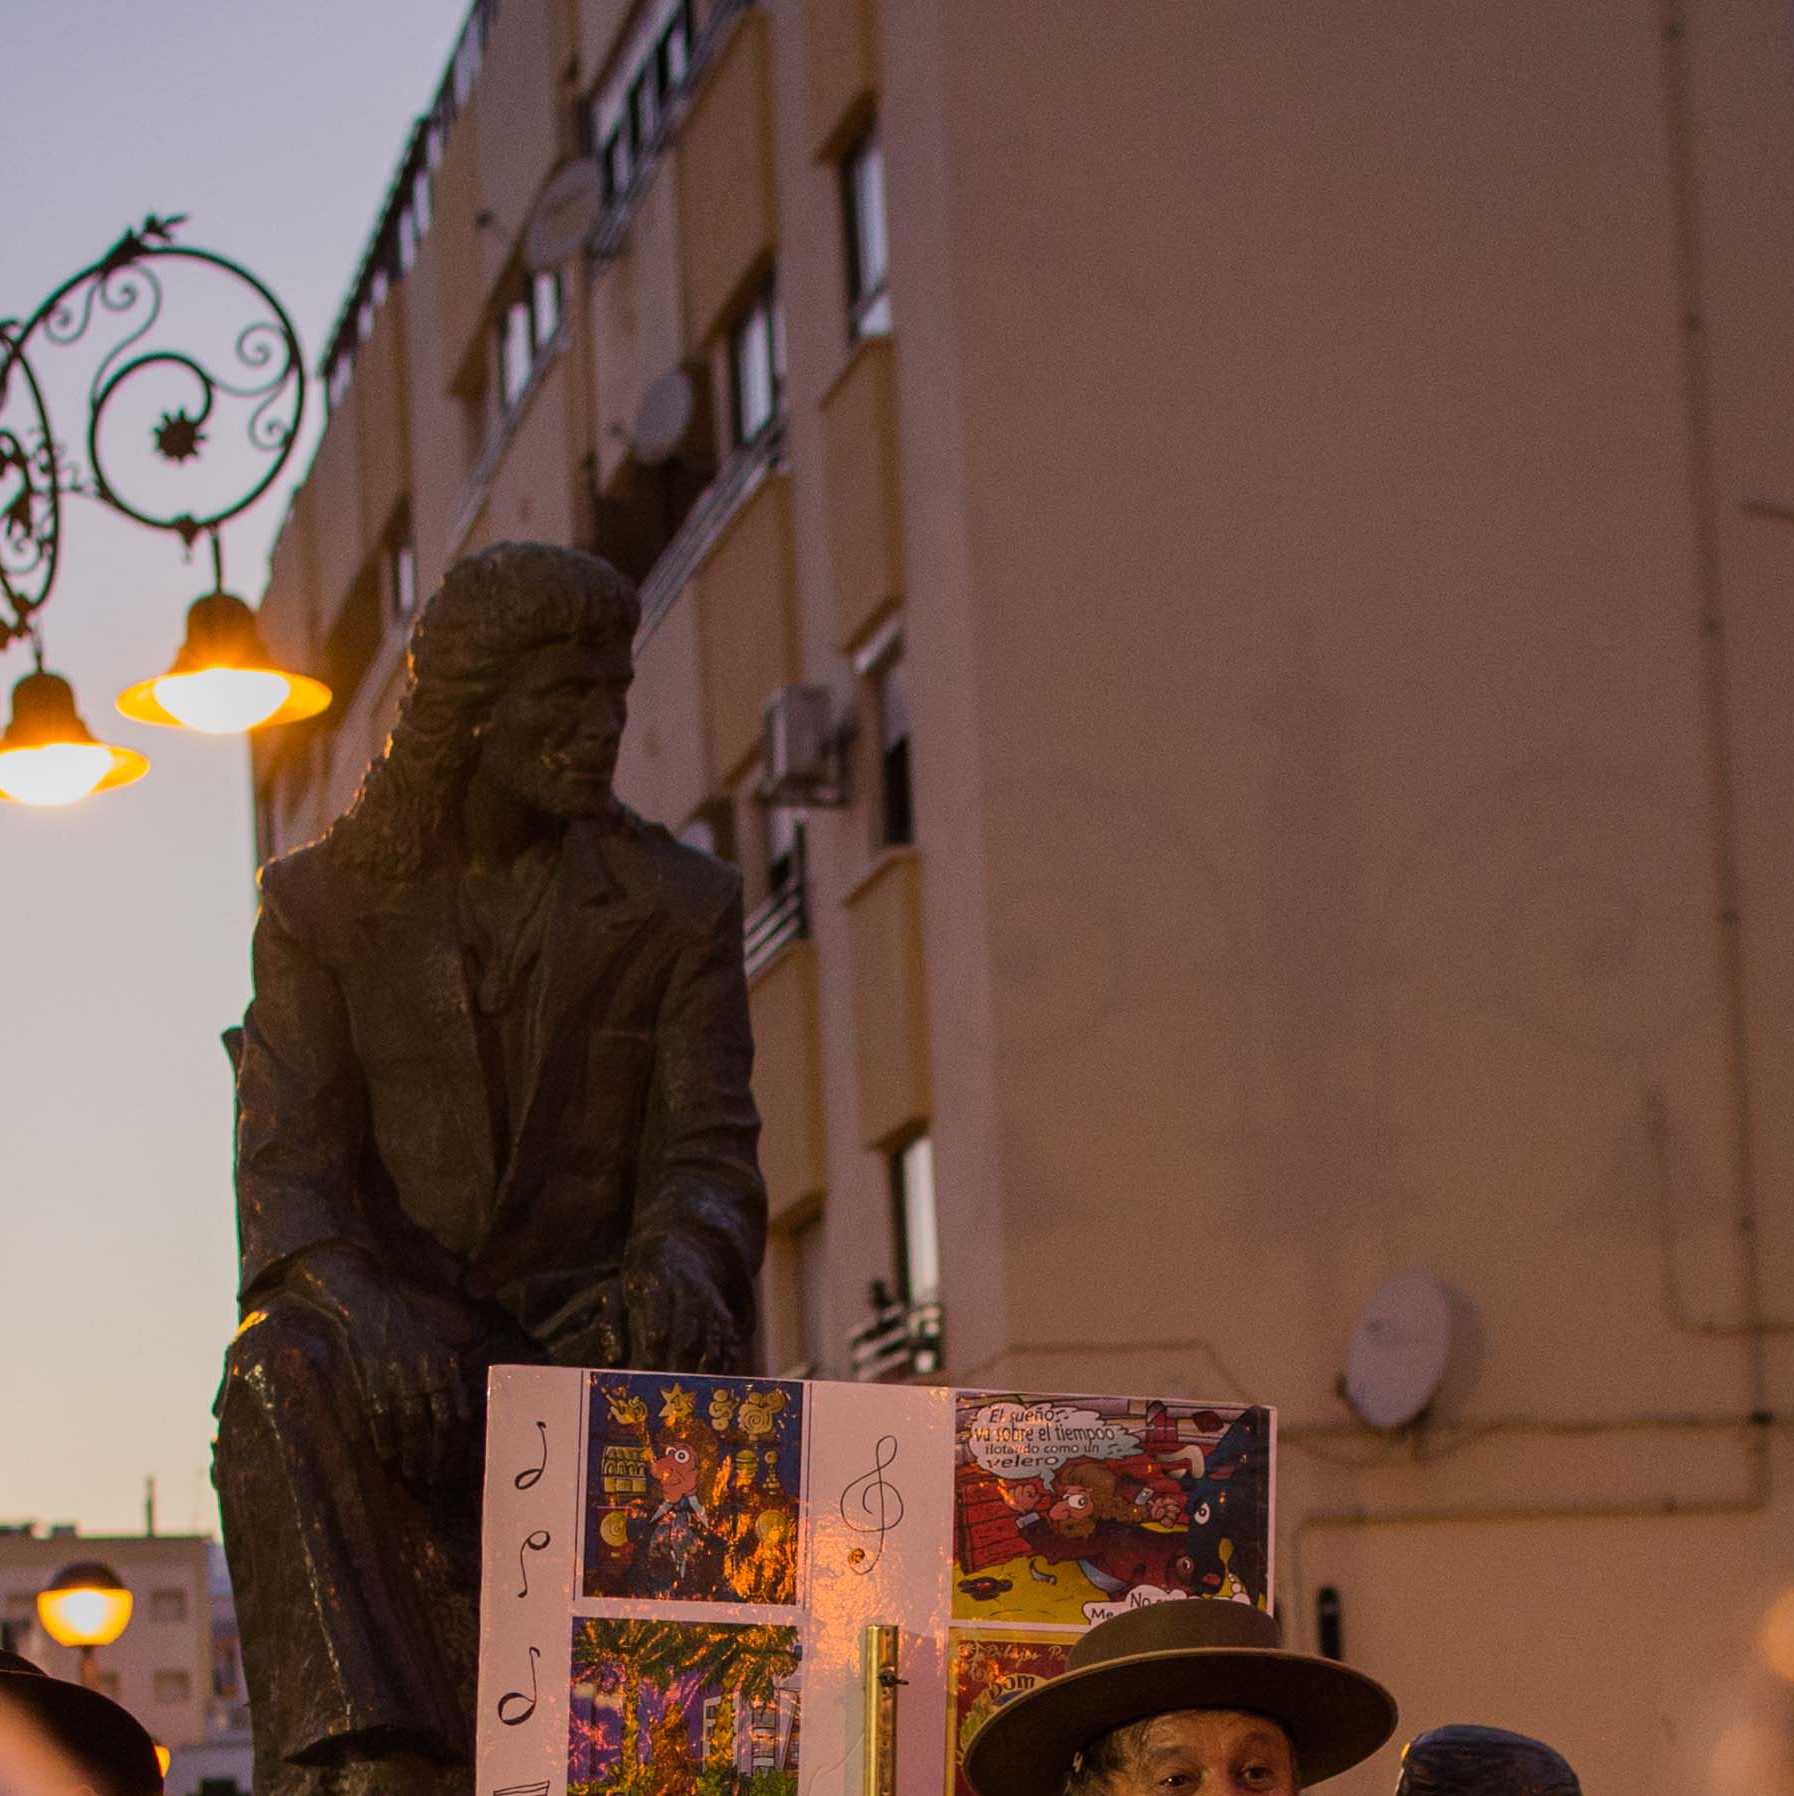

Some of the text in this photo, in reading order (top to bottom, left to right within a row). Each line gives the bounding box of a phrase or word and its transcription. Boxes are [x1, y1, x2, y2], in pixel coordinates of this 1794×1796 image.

[990, 1406, 1054, 1423] El sueño
[974, 1428, 990, 1441] va
[996, 1422, 1033, 1442] sobre
[1038, 1423, 1051, 1441] el
[1044, 1445, 1079, 1453] como
[1085, 1444, 1099, 1453] un
[987, 1454, 1059, 1468] velero
[1130, 1592, 1151, 1608] No
